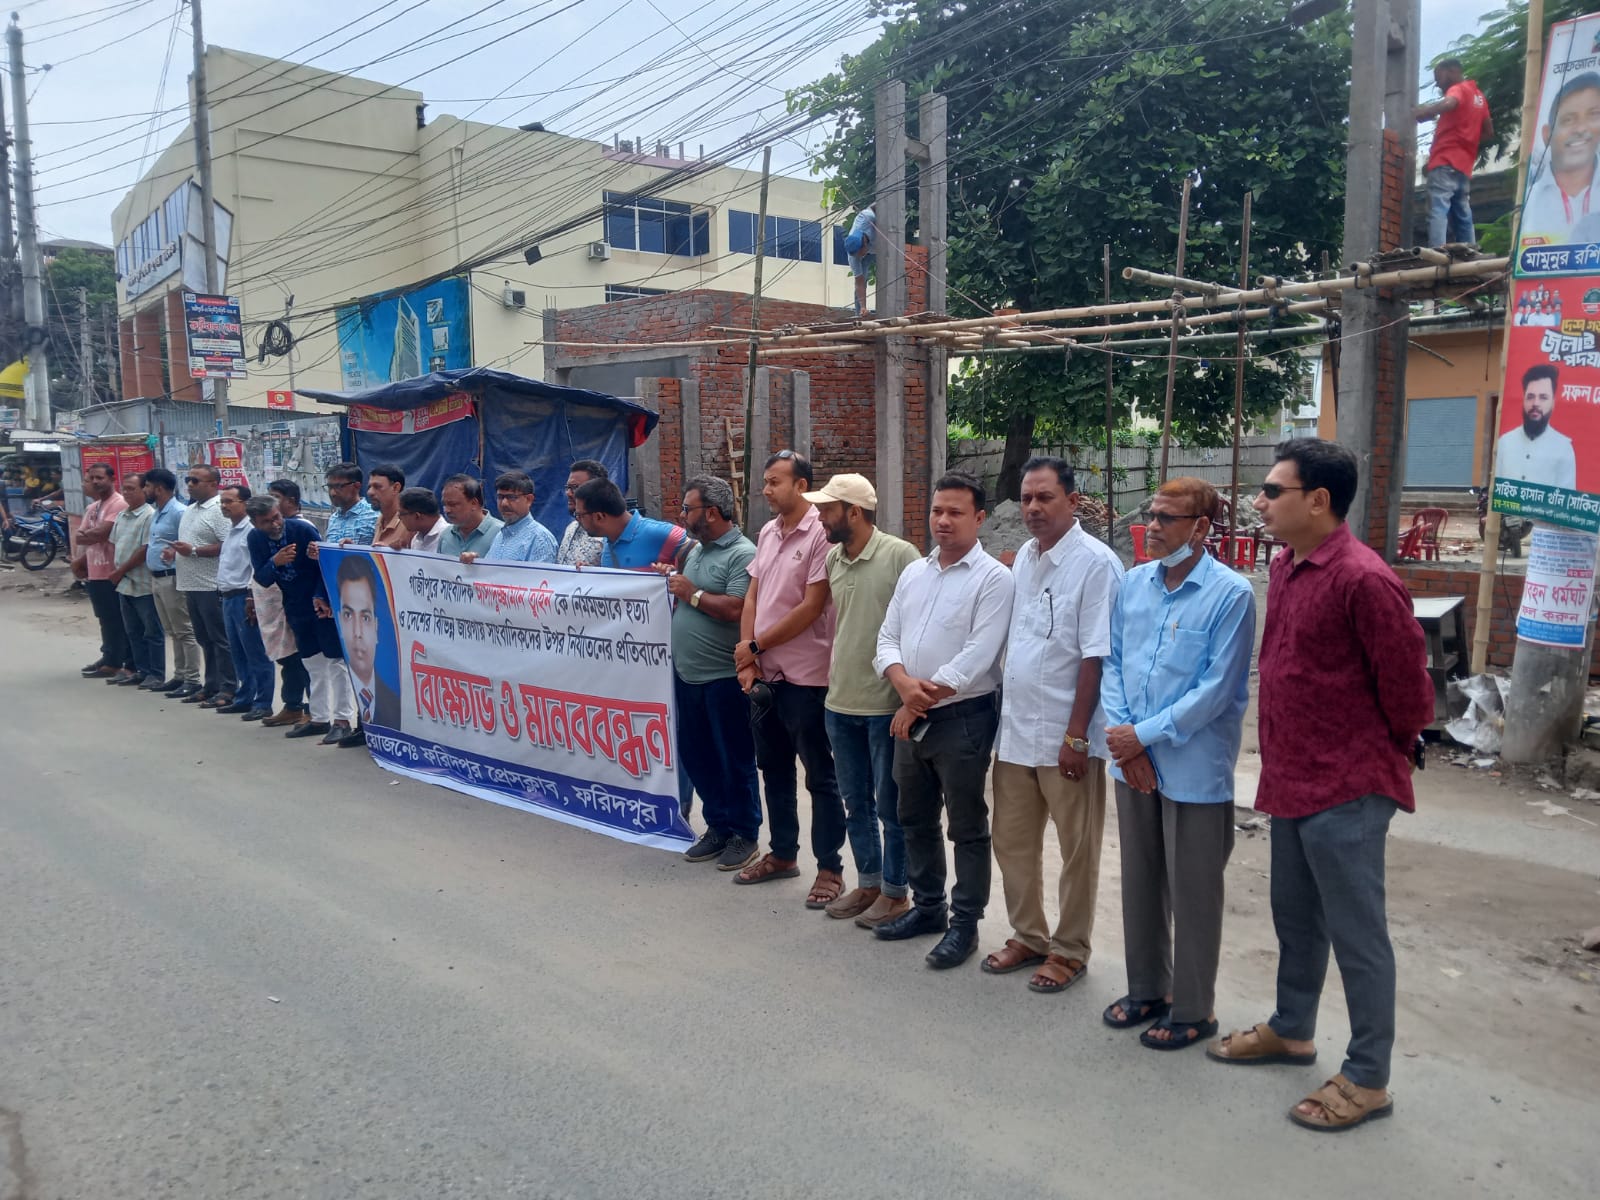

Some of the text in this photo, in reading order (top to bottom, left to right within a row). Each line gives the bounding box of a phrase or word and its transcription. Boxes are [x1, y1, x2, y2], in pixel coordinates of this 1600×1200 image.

[1553, 56, 1597, 74] আফজাল
[1526, 243, 1600, 270] মামুনুর রশি
[1541, 329, 1595, 361] জুলাই
[1563, 352, 1600, 367] পদযা
[1562, 384, 1592, 402] সফল
[1520, 487, 1545, 503] হাসান
[409, 568, 439, 604] গাজীপুরে
[440, 575, 474, 604] সাংবাদিক
[528, 580, 554, 619] তুহিন
[554, 593, 569, 616] কে
[571, 586, 622, 622] নির্মমভাবে
[623, 597, 650, 625] হত্যা
[1526, 579, 1587, 607] বহন ধর্মঘট
[1542, 609, 1580, 623] করুন
[406, 610, 432, 632] দেশের
[433, 607, 455, 641] বিভিন্ন
[455, 618, 486, 642] জায়গায়
[485, 618, 541, 652] সাংবাদিকদের
[541, 622, 566, 654] উপর
[567, 625, 614, 662] নির্যাতনের
[409, 639, 673, 779] বিক্ষোভ ও মানববন্ধন
[365, 732, 419, 761] য়োজনেঃ
[420, 744, 483, 783] ফরিদপুর
[485, 764, 560, 801] প্রেসক্লাব
[571, 784, 659, 829] ফরিদপুর
